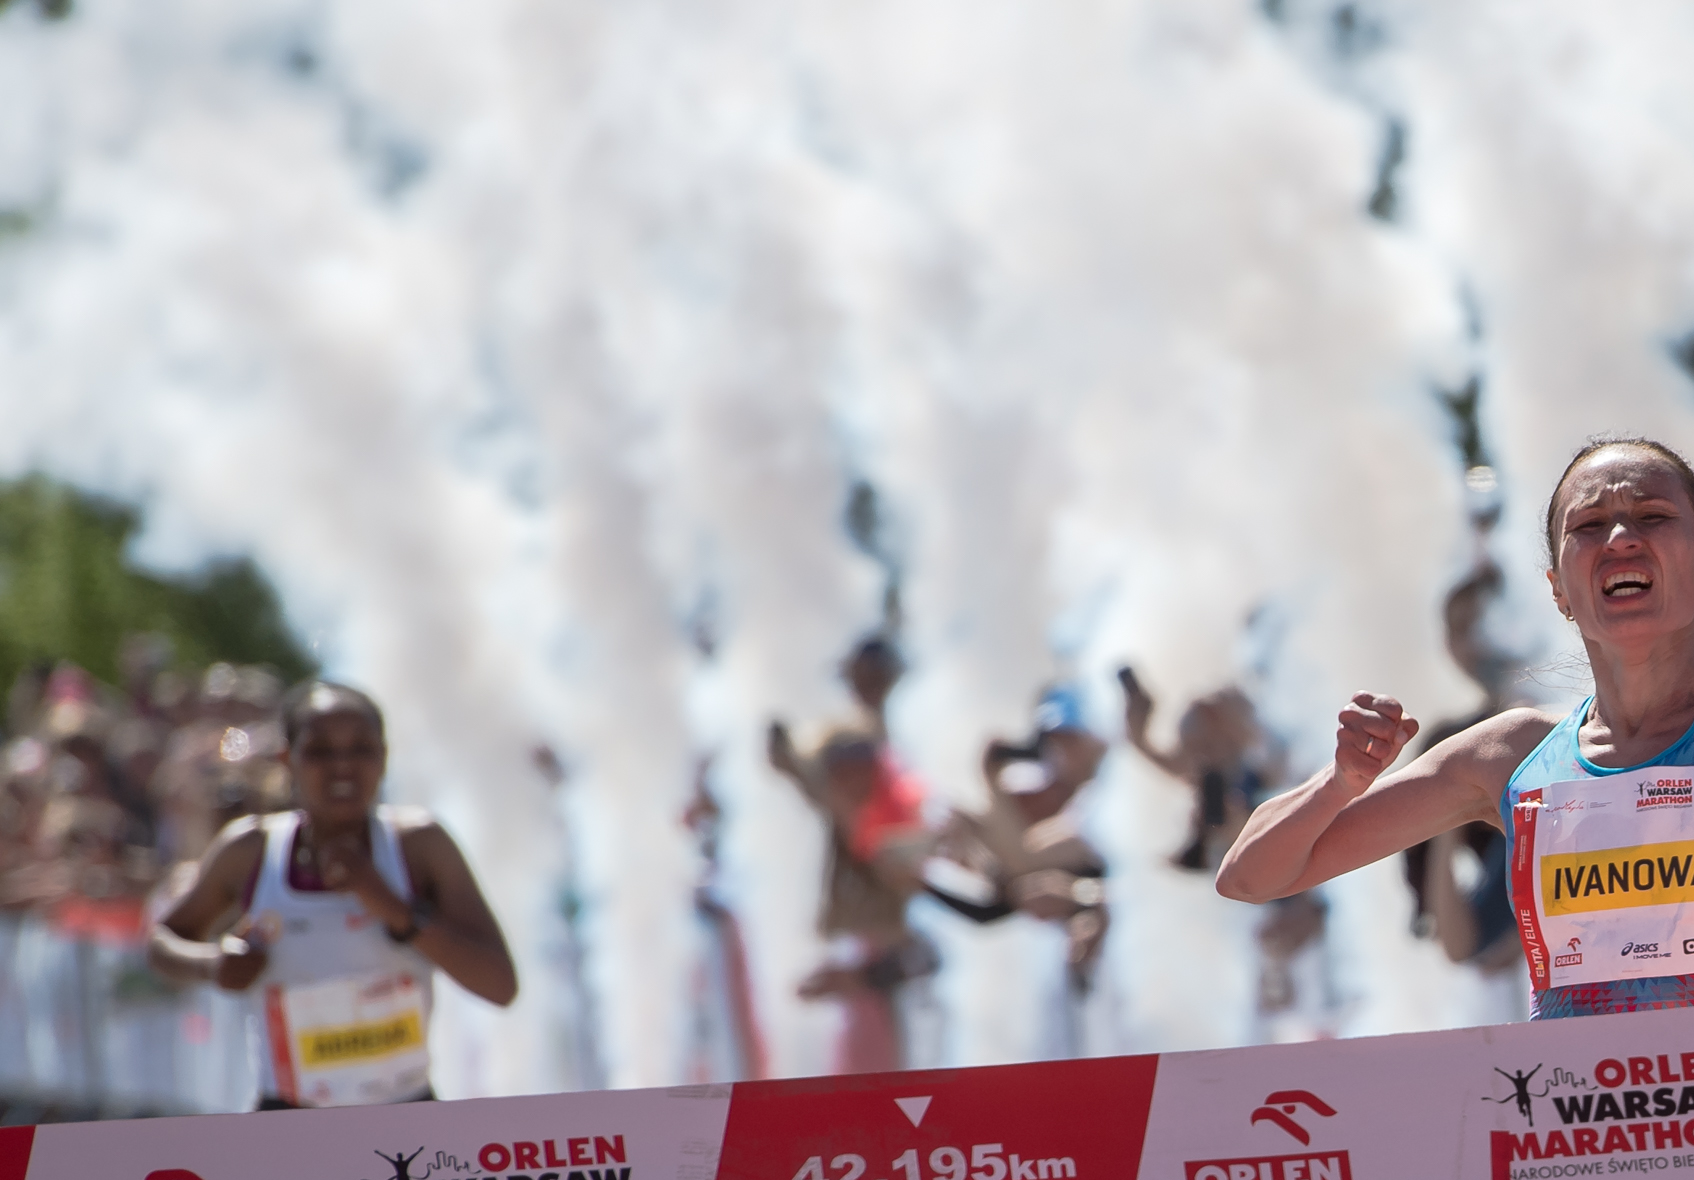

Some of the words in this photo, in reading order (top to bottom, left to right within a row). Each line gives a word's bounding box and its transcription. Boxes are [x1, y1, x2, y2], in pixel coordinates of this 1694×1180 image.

[1656, 779, 1692, 787] ORLEN
[1646, 787, 1693, 797] WARSAW
[1636, 795, 1693, 808] MARATHON
[1520, 909, 1536, 940] ELITE
[1531, 947, 1545, 978] ELITA
[1556, 954, 1581, 966] ORLEN
[478, 1135, 627, 1173] ORLEN
[1608, 1156, 1668, 1174] ŚWIĘTO
